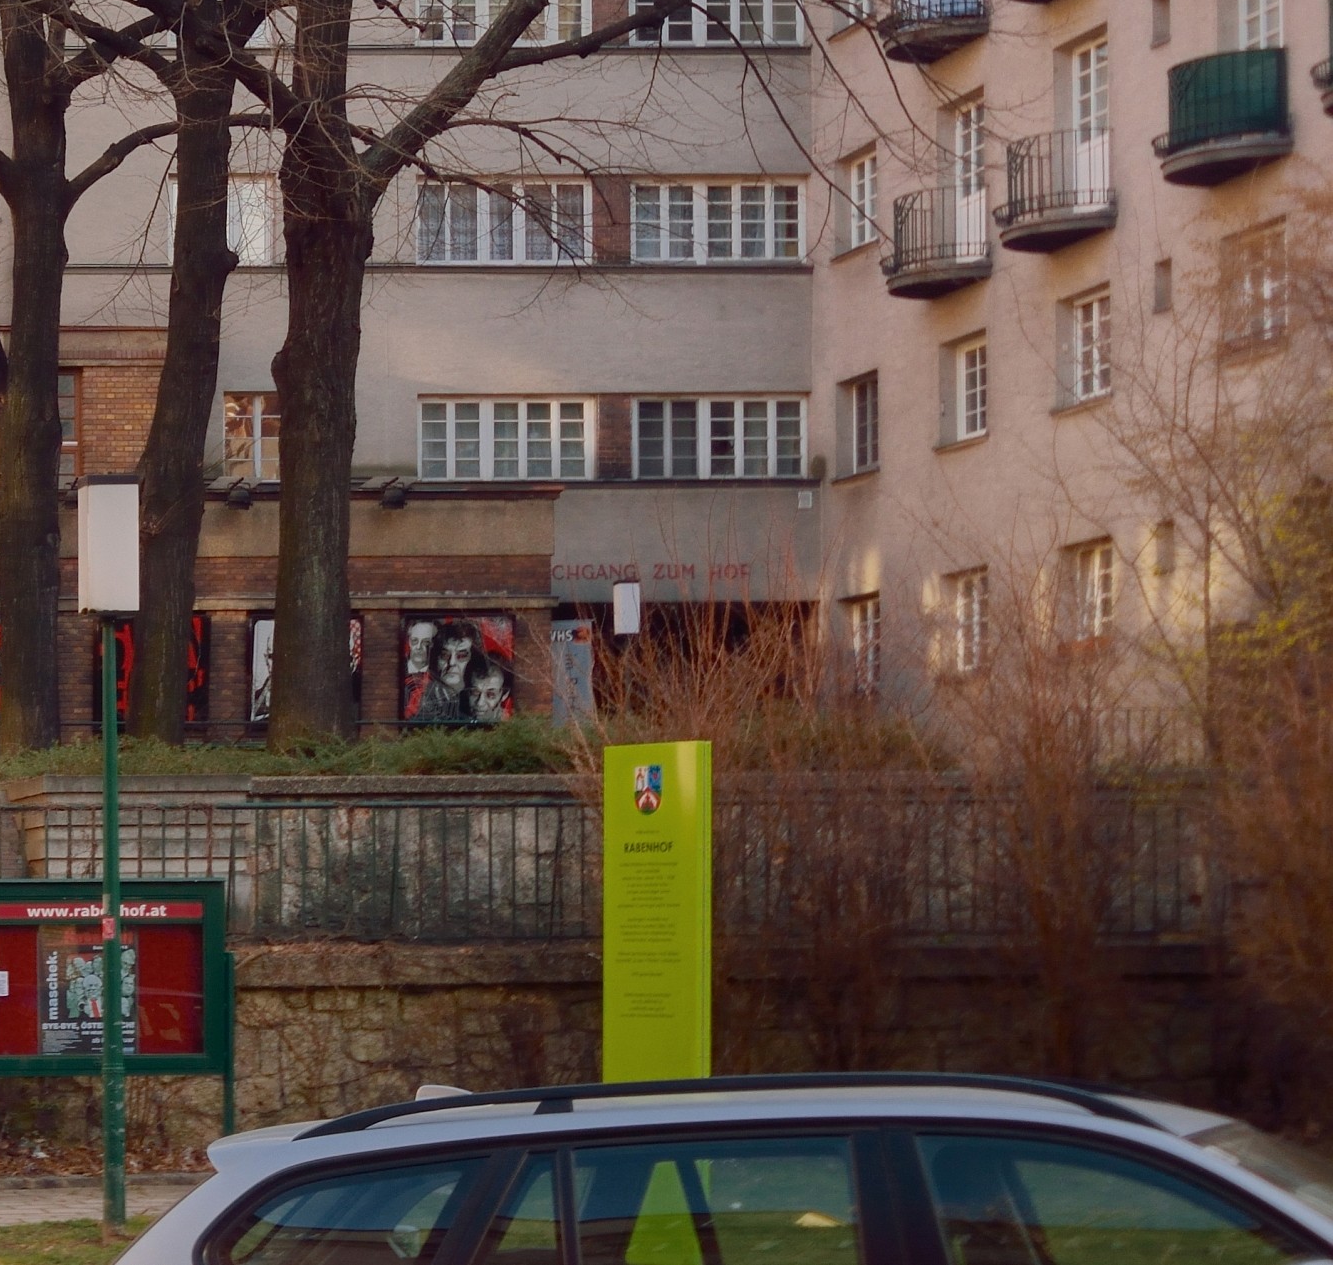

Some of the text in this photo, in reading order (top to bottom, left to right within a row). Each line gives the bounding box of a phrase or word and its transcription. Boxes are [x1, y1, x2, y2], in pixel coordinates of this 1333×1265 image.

[653, 563, 696, 580] ZUM
[623, 840, 674, 854] RABENHOF
[27, 904, 167, 918] www.rabehof.at
[45, 950, 59, 1021] maschek.
